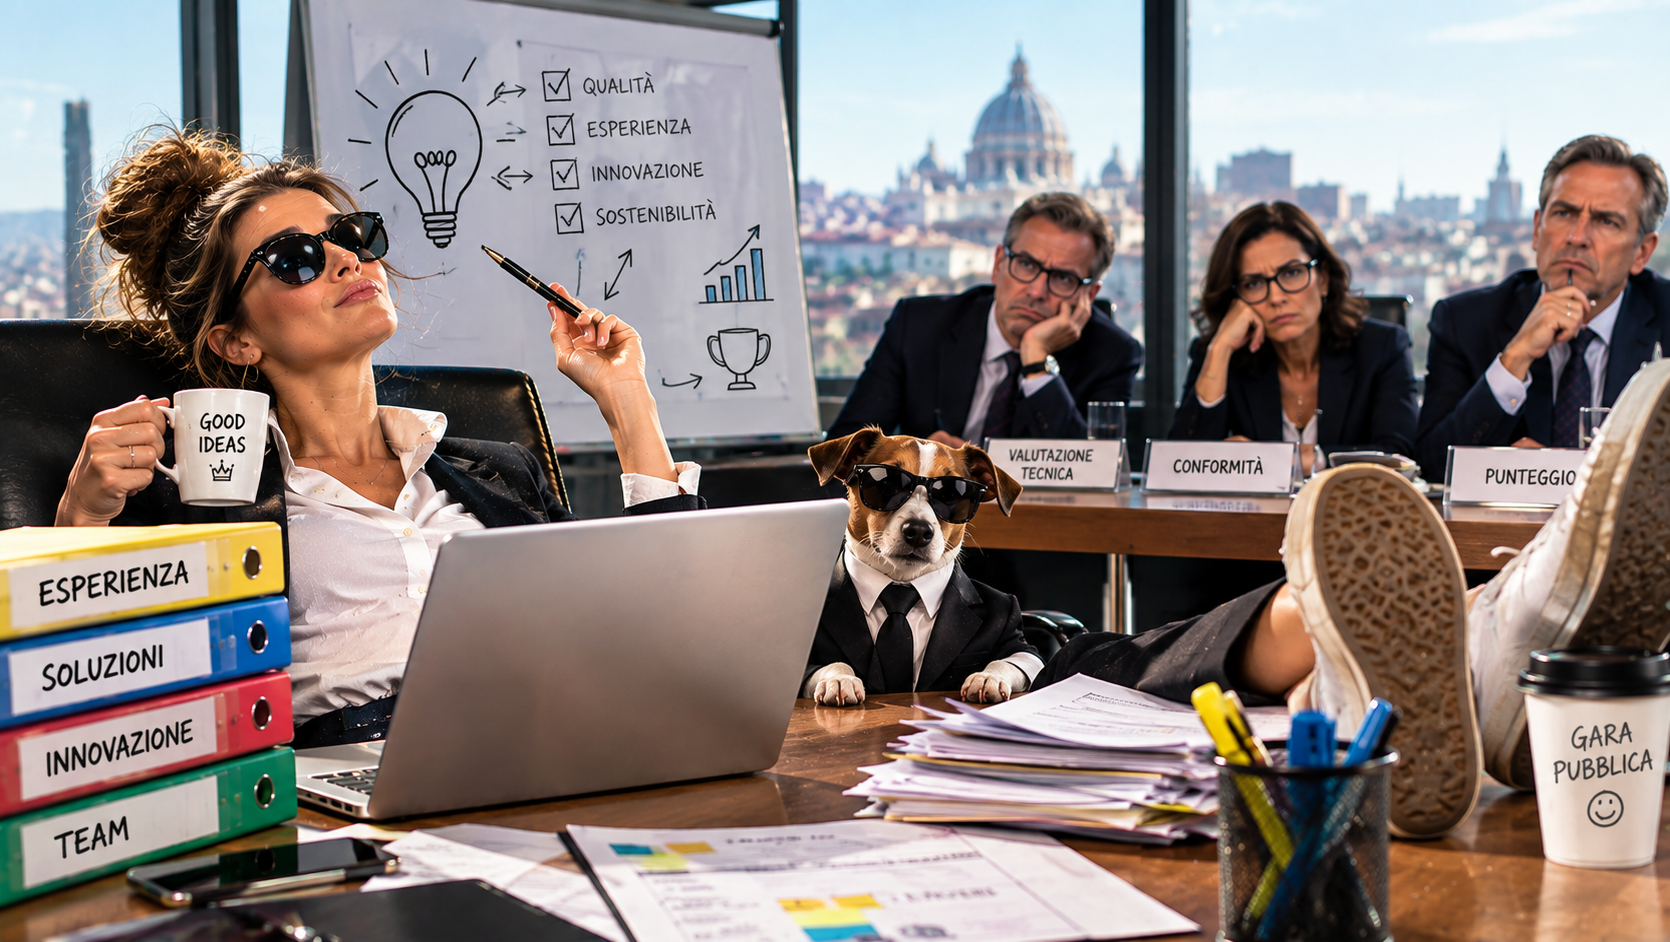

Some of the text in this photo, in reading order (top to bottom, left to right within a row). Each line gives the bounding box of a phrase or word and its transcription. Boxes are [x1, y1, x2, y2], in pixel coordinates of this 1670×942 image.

[582, 71, 655, 96] QUALITÀ
[587, 117, 692, 138] ESPERIENZA
[591, 161, 704, 183] INNOVAZIONE
[595, 199, 717, 227] SOSTENIBILITÀ
[199, 412, 246, 433] GOOD
[199, 435, 246, 455] IDEAS
[1008, 448, 1094, 464] VALUTAZIONE
[1020, 466, 1074, 482] TECNICA
[1172, 454, 1264, 475] CONFORMITÀ
[1485, 468, 1577, 486] PUNTEGGIO
[38, 559, 189, 607] ESPERIENZA
[41, 644, 164, 692] SOLUZIONI
[45, 718, 194, 778] INNOVAZIONE
[1571, 721, 1633, 752] GARA
[1553, 748, 1653, 784] PUBBLICA
[54, 816, 130, 860] TEAM
